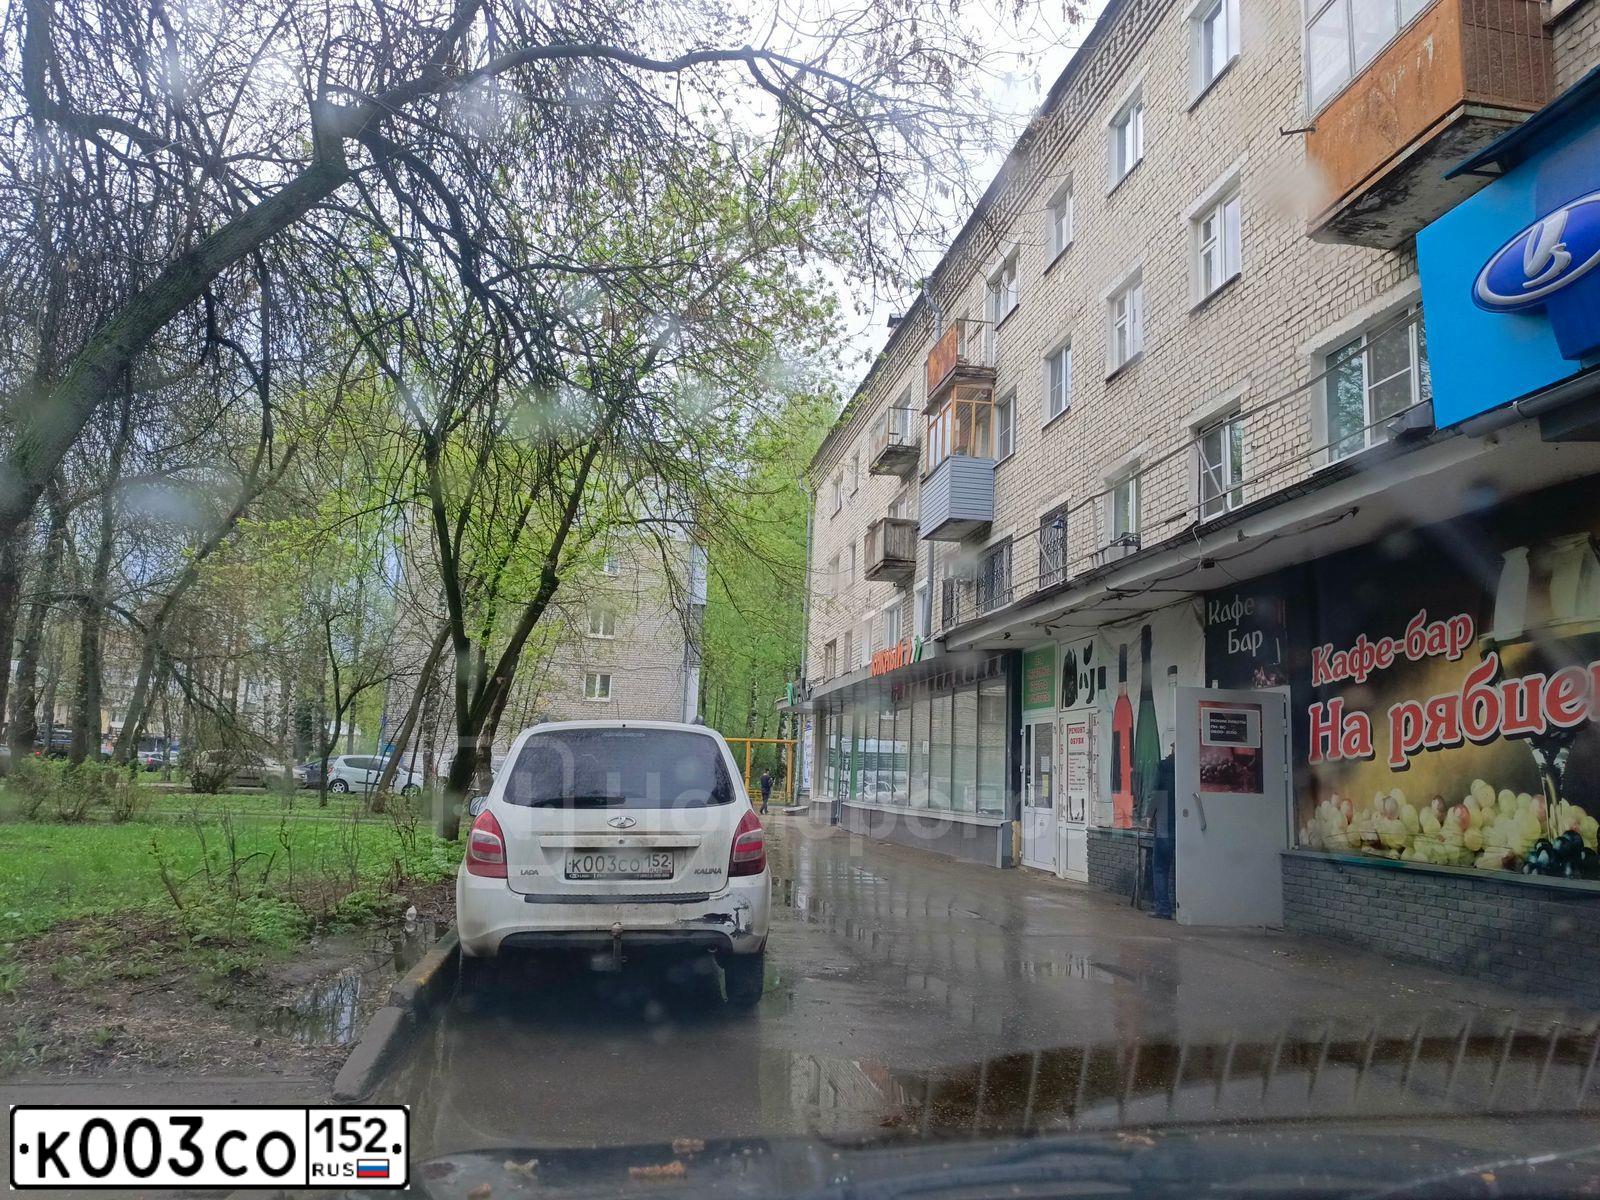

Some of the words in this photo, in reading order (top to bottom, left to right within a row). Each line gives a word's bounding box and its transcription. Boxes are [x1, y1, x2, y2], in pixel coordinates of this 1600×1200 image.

[1207, 592, 1256, 626] Кафе
[1227, 627, 1264, 657] Бар
[1311, 608, 1474, 688] Кафе-бар
[1068, 726, 1086, 735] РЕМОНТ
[1308, 697, 1374, 766] На
[644, 853, 669, 868] 152
